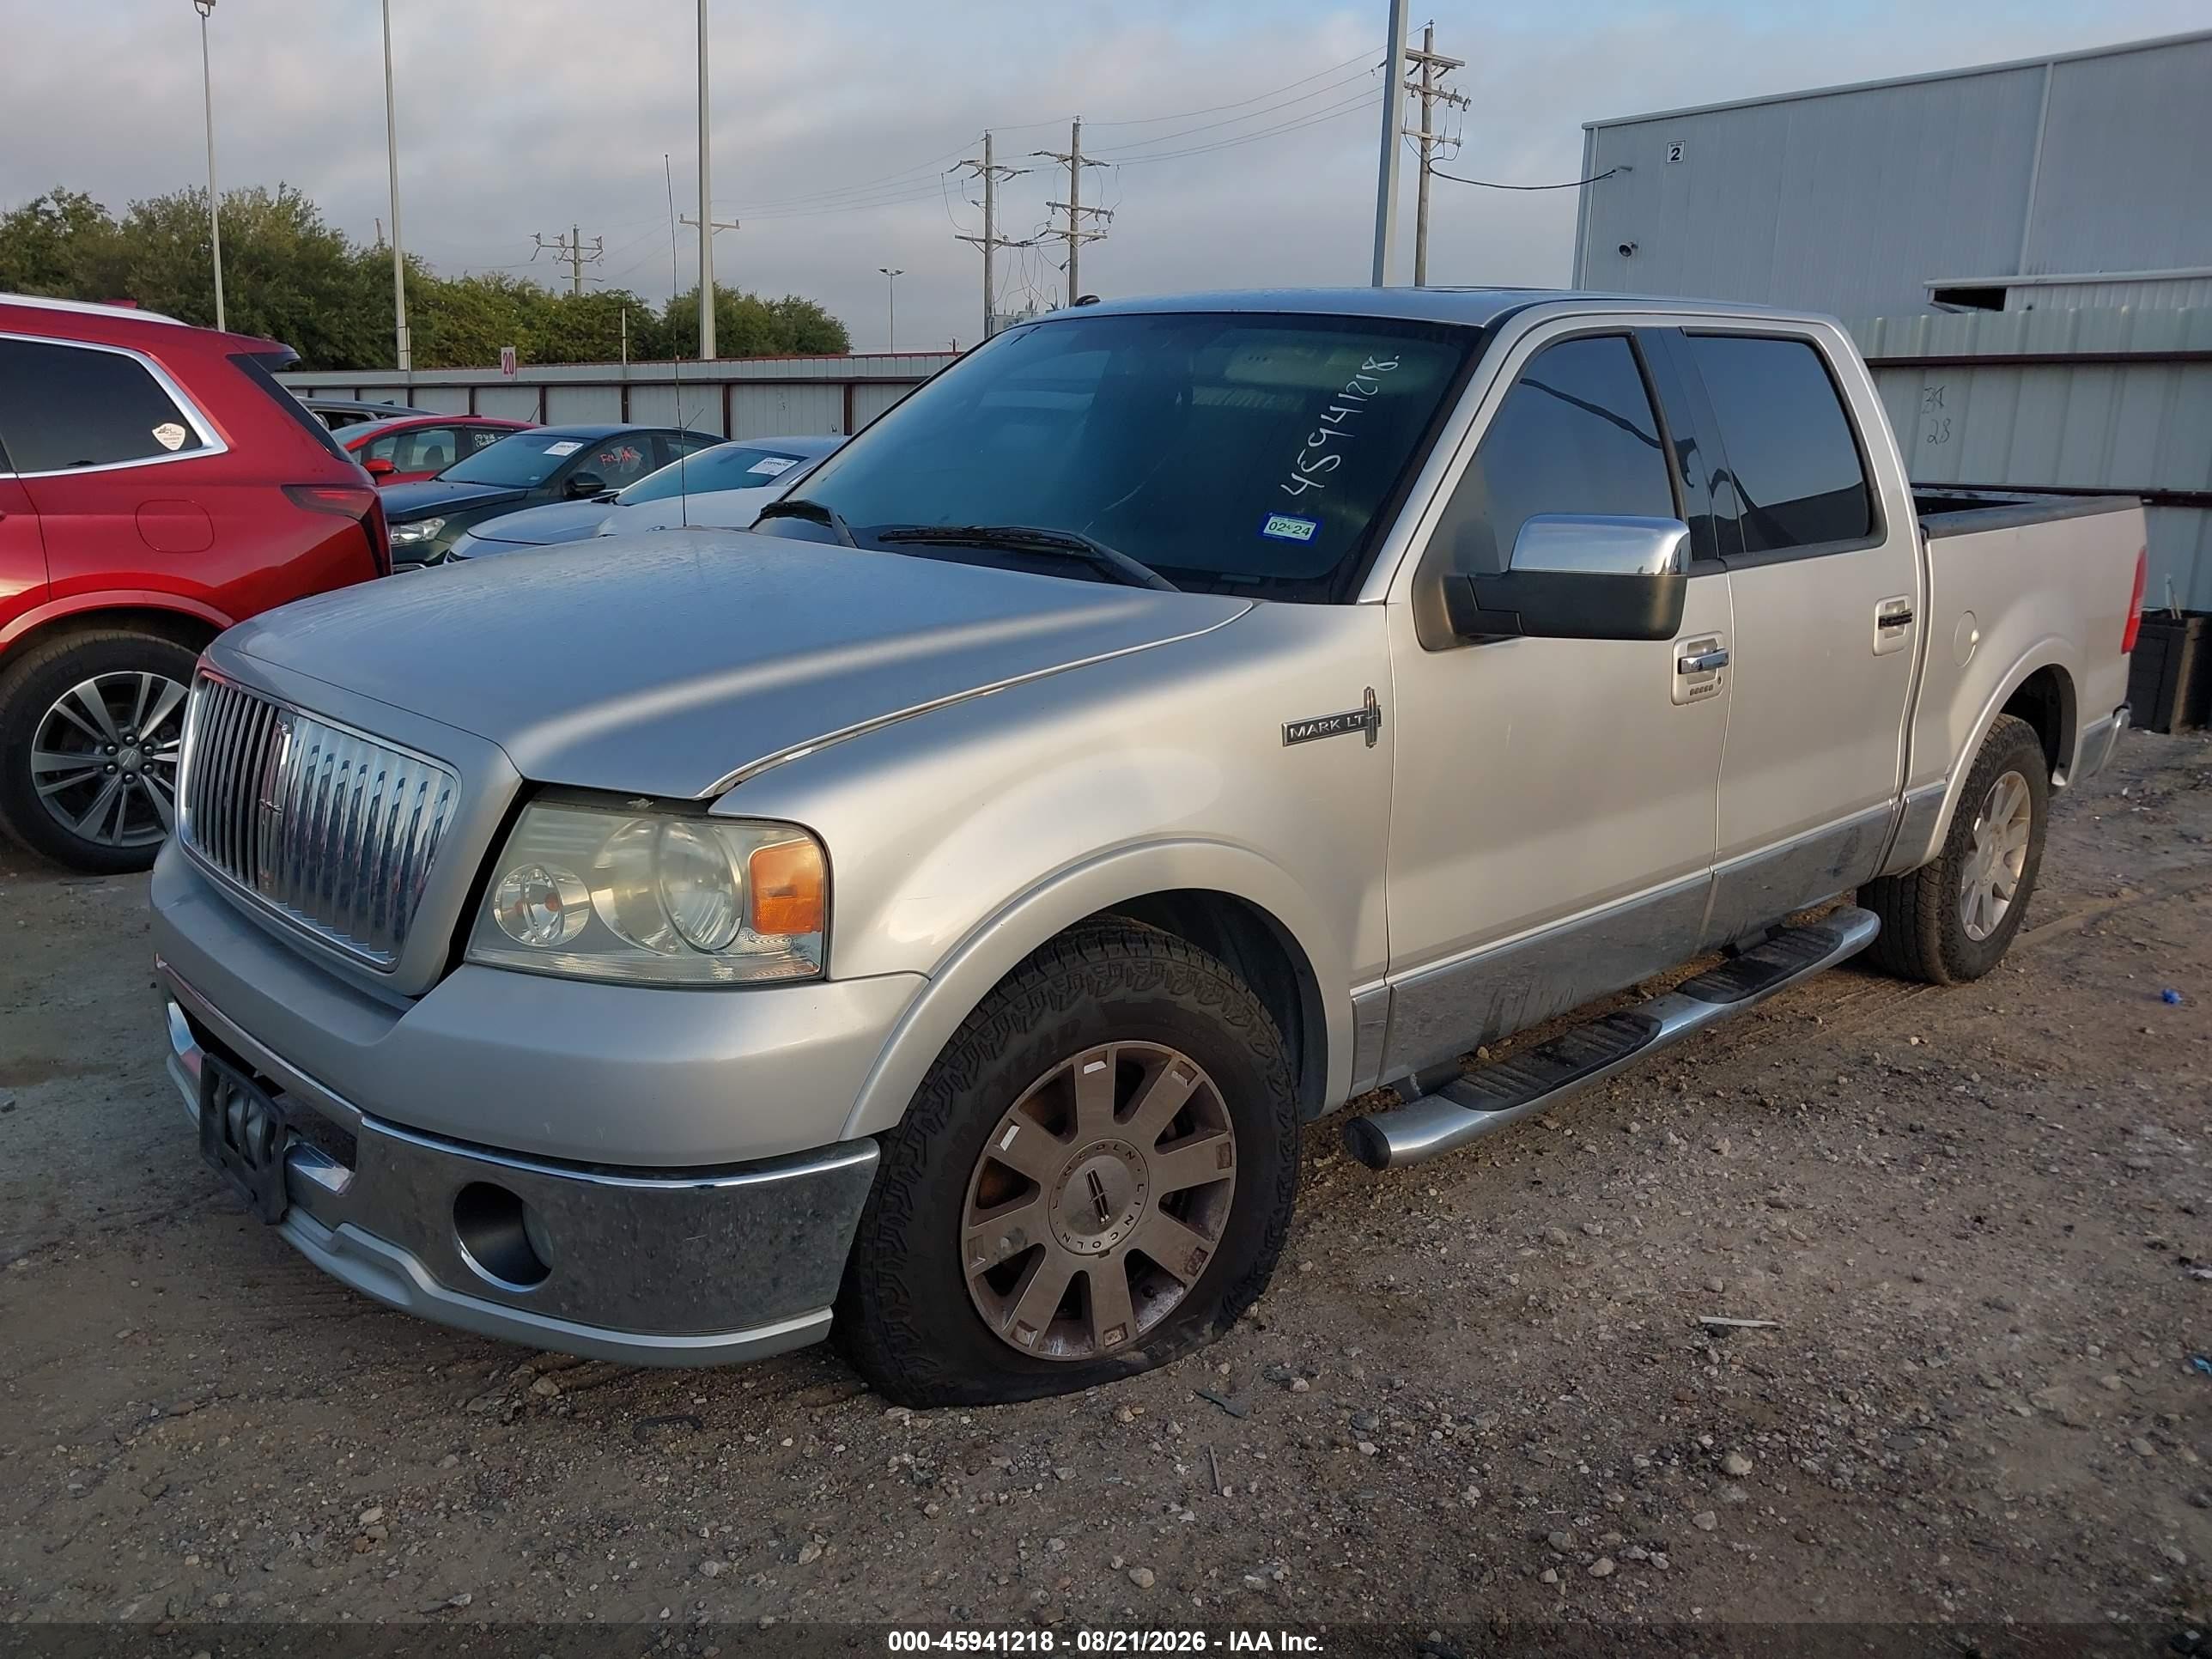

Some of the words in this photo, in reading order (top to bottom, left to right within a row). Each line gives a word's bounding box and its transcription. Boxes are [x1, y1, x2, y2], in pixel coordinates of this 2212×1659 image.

[1670, 147, 1681, 161] 2
[502, 351, 515, 375] 20
[1290, 719, 1341, 739] MARK
[1346, 714, 1365, 728] LT
[1052, 1143, 1136, 1211] LINCOLN
[1061, 1182, 1146, 1250] LINCOLN
